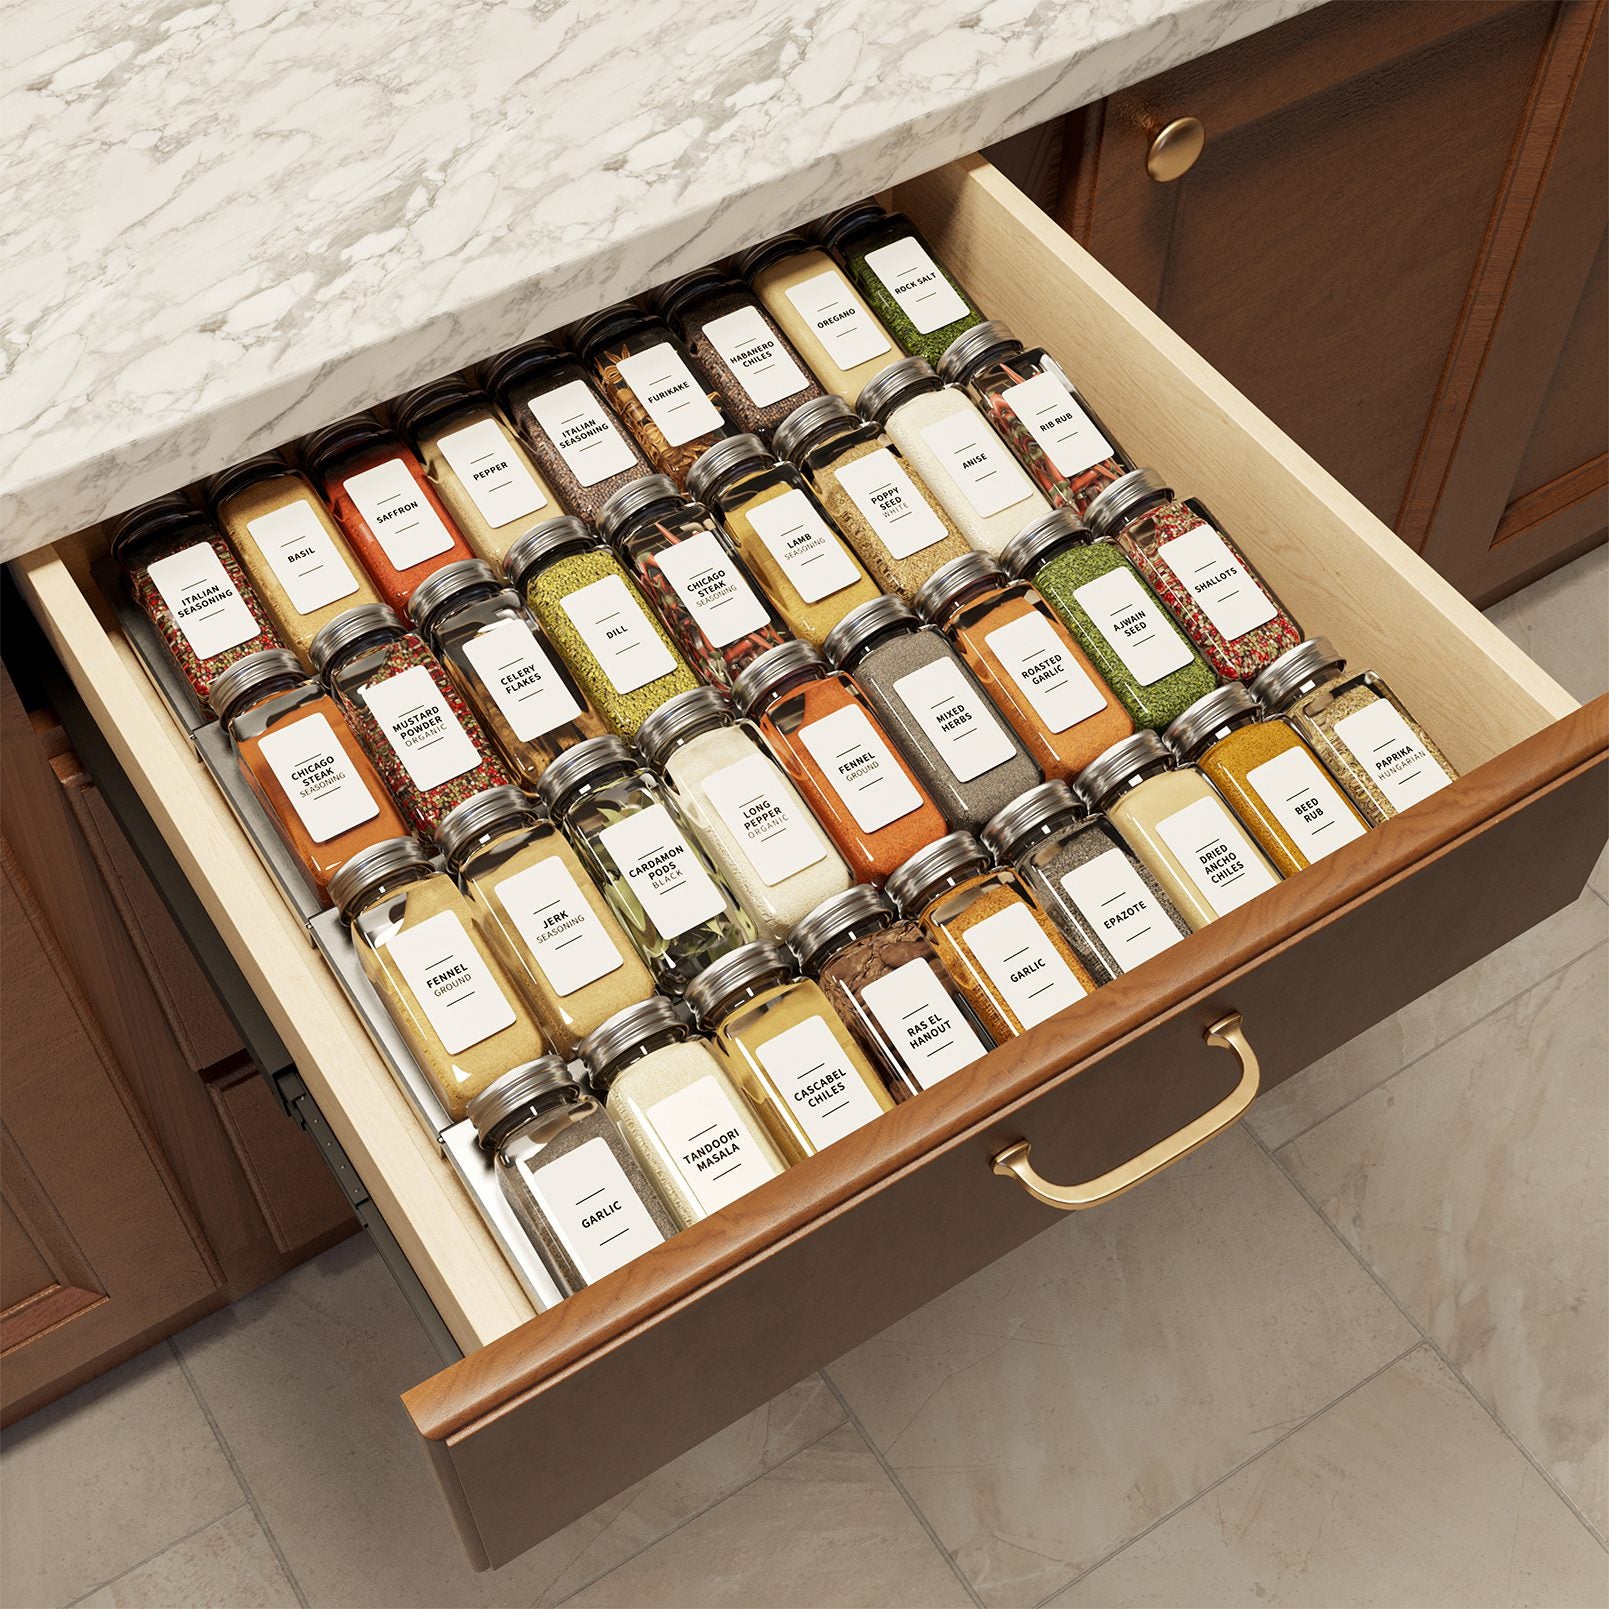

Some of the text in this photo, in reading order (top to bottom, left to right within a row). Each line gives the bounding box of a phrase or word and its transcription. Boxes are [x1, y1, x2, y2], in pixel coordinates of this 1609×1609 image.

[894, 272, 936, 294] ROCK SALT
[816, 307, 857, 329] OREGANO
[729, 340, 775, 365] HABANERO
[742, 350, 773, 368] CHILES
[647, 380, 691, 404] FURIKAKE
[561, 418, 597, 439] ITALIAN
[1040, 413, 1073, 432] RIB RUB
[558, 422, 610, 450] SEASONING
[472, 461, 509, 482] PEPPER
[962, 452, 988, 470] ANISE
[870, 486, 900, 505] POPPY
[879, 495, 903, 511] SEED
[375, 500, 419, 525] SAFFRON
[881, 502, 909, 519] WHITE
[783, 536, 827, 561] SEASONING
[786, 532, 813, 550] LAMB
[287, 546, 316, 564] BASIL
[686, 569, 726, 593] CHICAGO
[697, 579, 727, 599] STEAK
[1193, 566, 1238, 594] SHALLOTS
[177, 588, 234, 619] SEASONING
[180, 584, 220, 607] ITALIAN
[695, 584, 738, 608] SEASONING
[605, 625, 629, 640] DILL
[1112, 609, 1147, 633] AJWAIN
[1123, 621, 1148, 638] SEED
[500, 663, 536, 686] CELERY
[1020, 653, 1063, 680] ROASTED
[1031, 663, 1065, 686] GARLIC
[504, 672, 542, 695] FLAKES
[391, 705, 440, 733] MUSTARD
[935, 704, 966, 724] MIXED
[940, 711, 973, 733] HERBS
[399, 715, 443, 741] POWDER
[404, 722, 448, 748] ORGANIC
[290, 755, 335, 781] CHICAGO
[837, 751, 876, 775] FENNEL
[1374, 745, 1414, 771] PAPRIKA
[1377, 750, 1427, 781] HUNGARIAN
[301, 766, 335, 788] STEAK
[845, 760, 880, 783] GROUND
[299, 771, 347, 799] SEASONING
[742, 799, 772, 820] LONG
[743, 806, 783, 831] PEPPER
[1293, 797, 1320, 816] BEED
[1302, 807, 1325, 824] RUB
[747, 813, 789, 839] ORGANIC
[628, 844, 685, 879] CARDAMON
[1198, 843, 1229, 865] DRIED
[1204, 851, 1237, 876] ANCHO
[647, 860, 677, 881] PODS
[651, 868, 684, 890] BLACK
[1210, 860, 1245, 884] CHILES
[542, 909, 570, 930] JERK
[1103, 900, 1148, 930] EPAZOTE
[535, 914, 586, 945] SEASONING
[425, 963, 469, 990] FENNEL
[1009, 957, 1047, 983] GARLIC
[433, 972, 472, 998] GROUND
[907, 1014, 942, 1037] RAS EL
[908, 1019, 952, 1050] HANOUT
[793, 1068, 847, 1102] CASCABEL
[807, 1081, 846, 1108] CHILES
[682, 1127, 740, 1165] TANDOORI
[695, 1142, 741, 1173] MASALA
[581, 1200, 623, 1229] GARLIC
